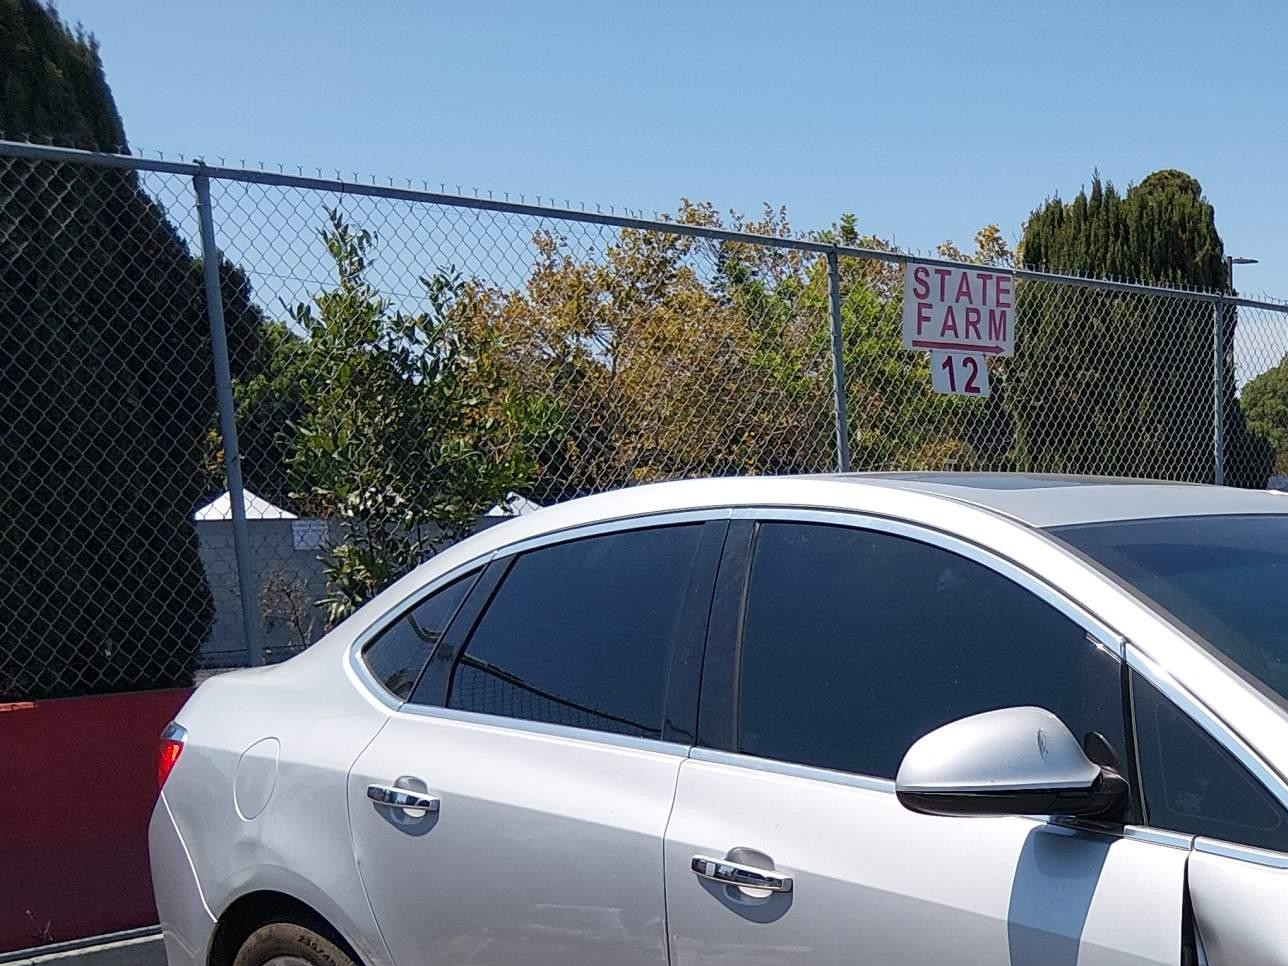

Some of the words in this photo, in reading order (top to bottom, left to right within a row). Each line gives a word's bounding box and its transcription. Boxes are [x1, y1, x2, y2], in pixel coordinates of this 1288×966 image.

[913, 266, 1011, 308] STATE
[917, 302, 1007, 341] FARM
[942, 355, 981, 393] 12
